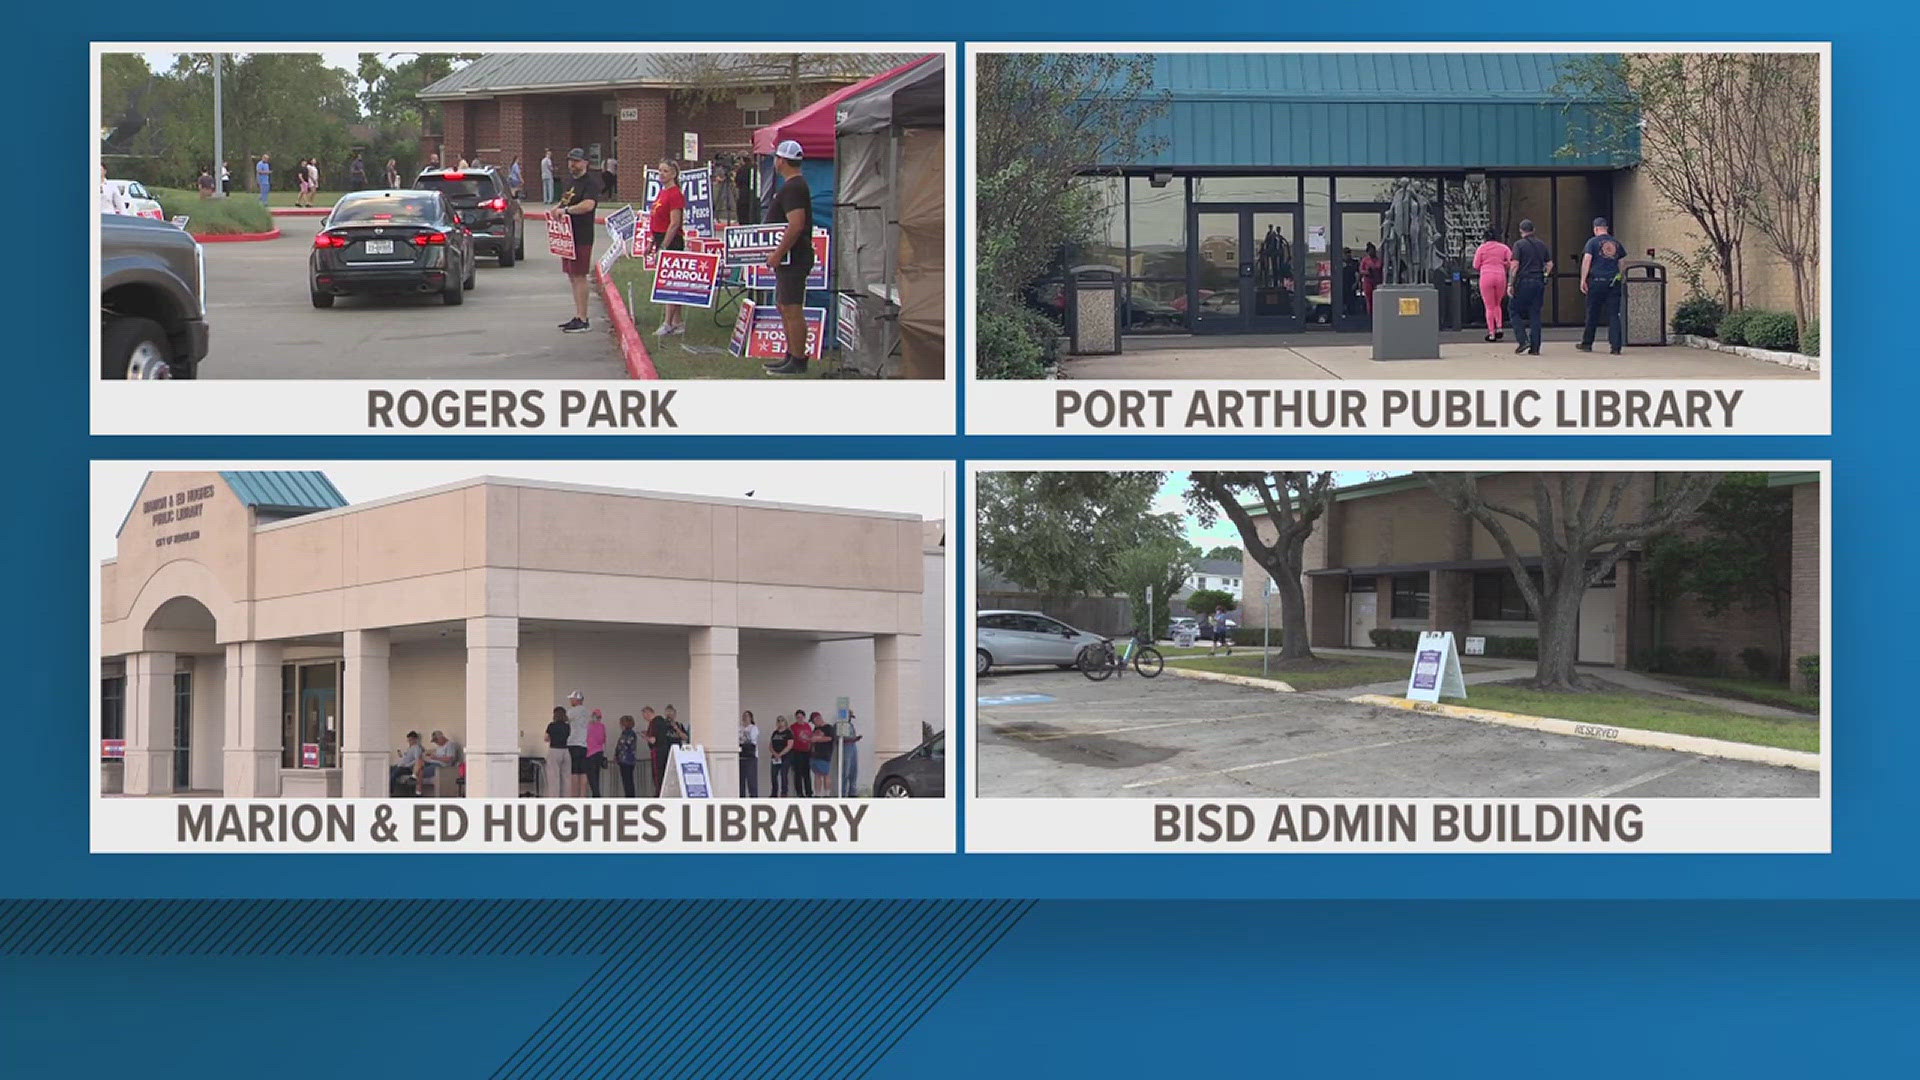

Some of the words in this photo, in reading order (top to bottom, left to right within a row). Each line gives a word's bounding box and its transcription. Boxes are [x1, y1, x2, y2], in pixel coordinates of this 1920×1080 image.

[728, 231, 785, 249] WILLIS
[661, 256, 698, 271] KATE
[660, 269, 710, 283] CARROLL
[1574, 724, 1620, 739] RESERVED
